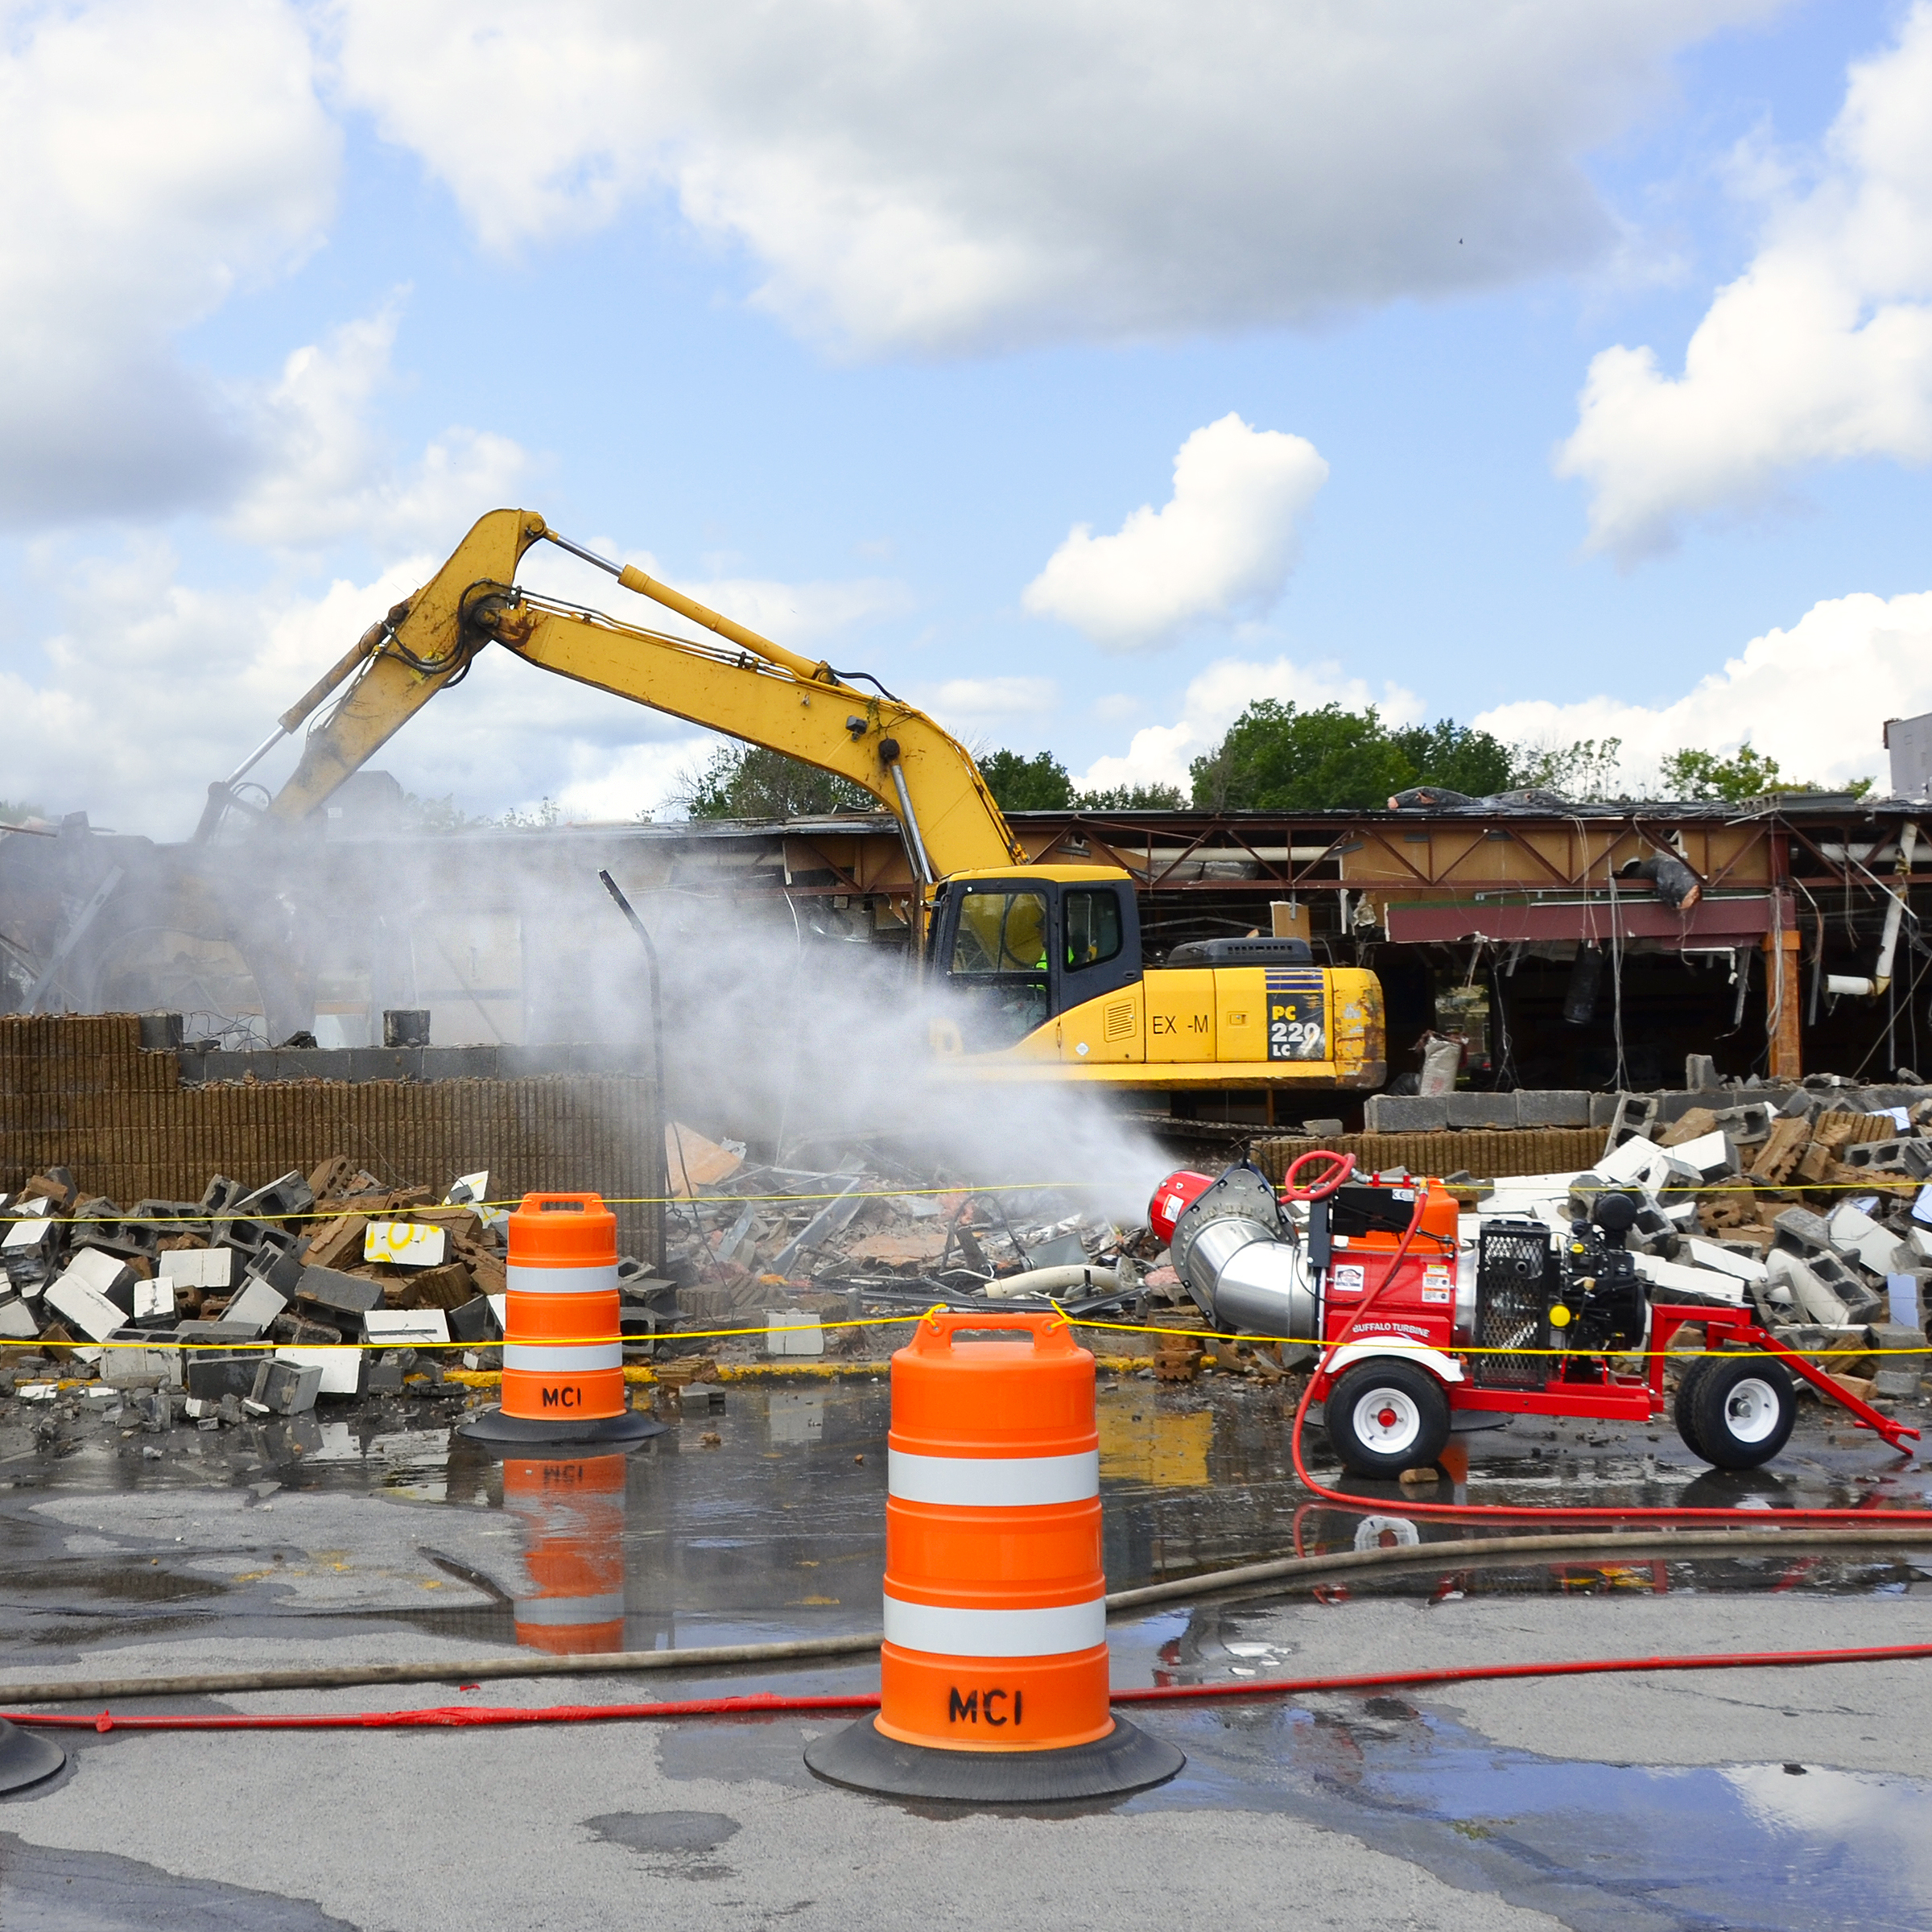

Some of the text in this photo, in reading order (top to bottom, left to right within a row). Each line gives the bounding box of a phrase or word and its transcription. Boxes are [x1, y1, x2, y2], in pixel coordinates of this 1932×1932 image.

[1272, 1005, 1296, 1021] PC
[1153, 1016, 1177, 1034] EX
[1273, 1044, 1290, 1056] LC
[1352, 1323, 1430, 1338] BUFFALO TURBINE
[543, 1387, 581, 1407] MCI
[950, 1687, 1022, 1726] MCI
